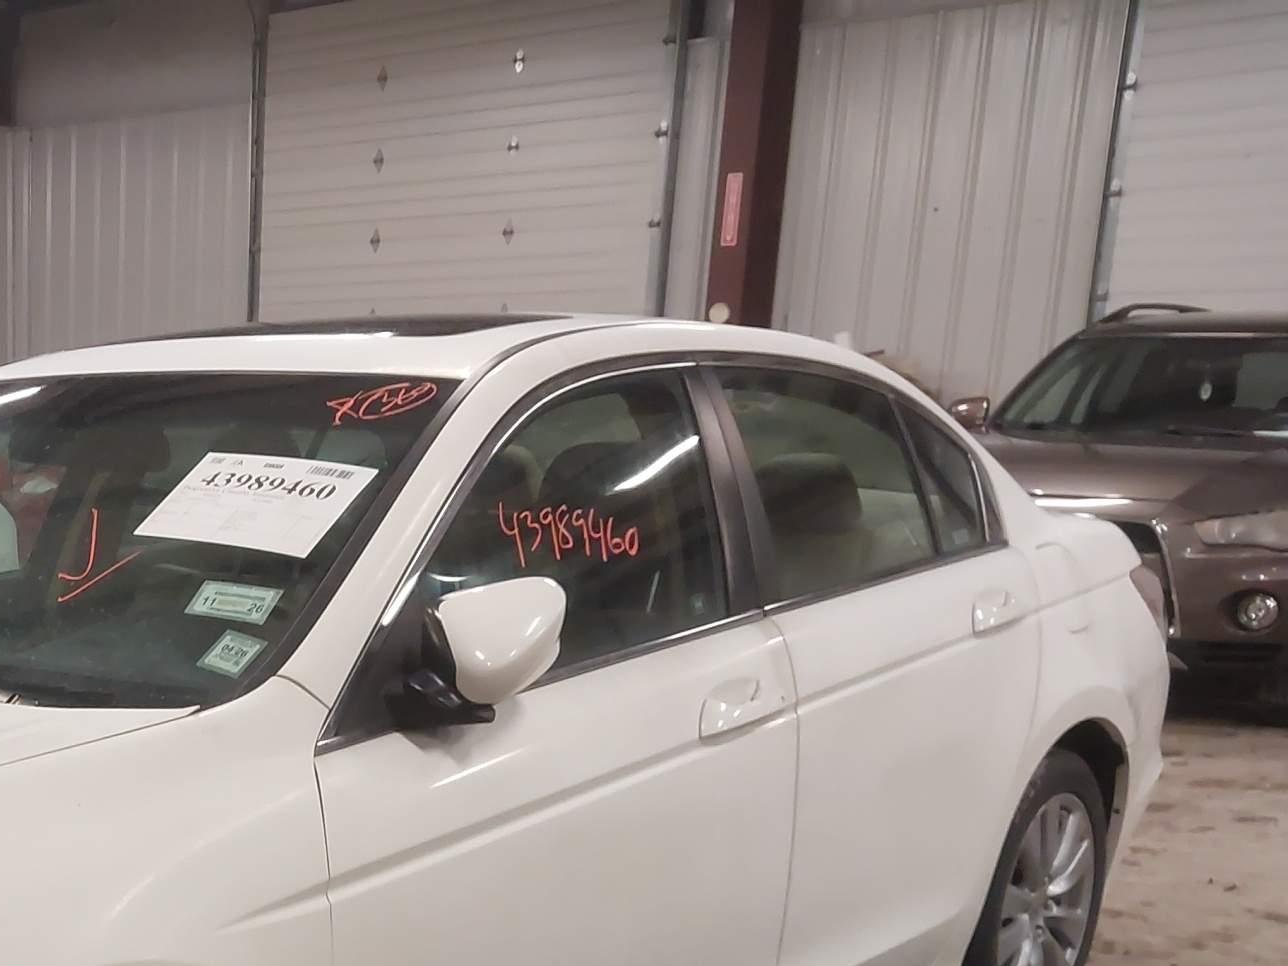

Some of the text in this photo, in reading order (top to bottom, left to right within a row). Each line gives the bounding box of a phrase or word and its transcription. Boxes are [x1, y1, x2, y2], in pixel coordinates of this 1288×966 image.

[201, 471, 338, 500] 43989460
[499, 501, 639, 568] 43989460
[202, 596, 264, 614] 11 26
